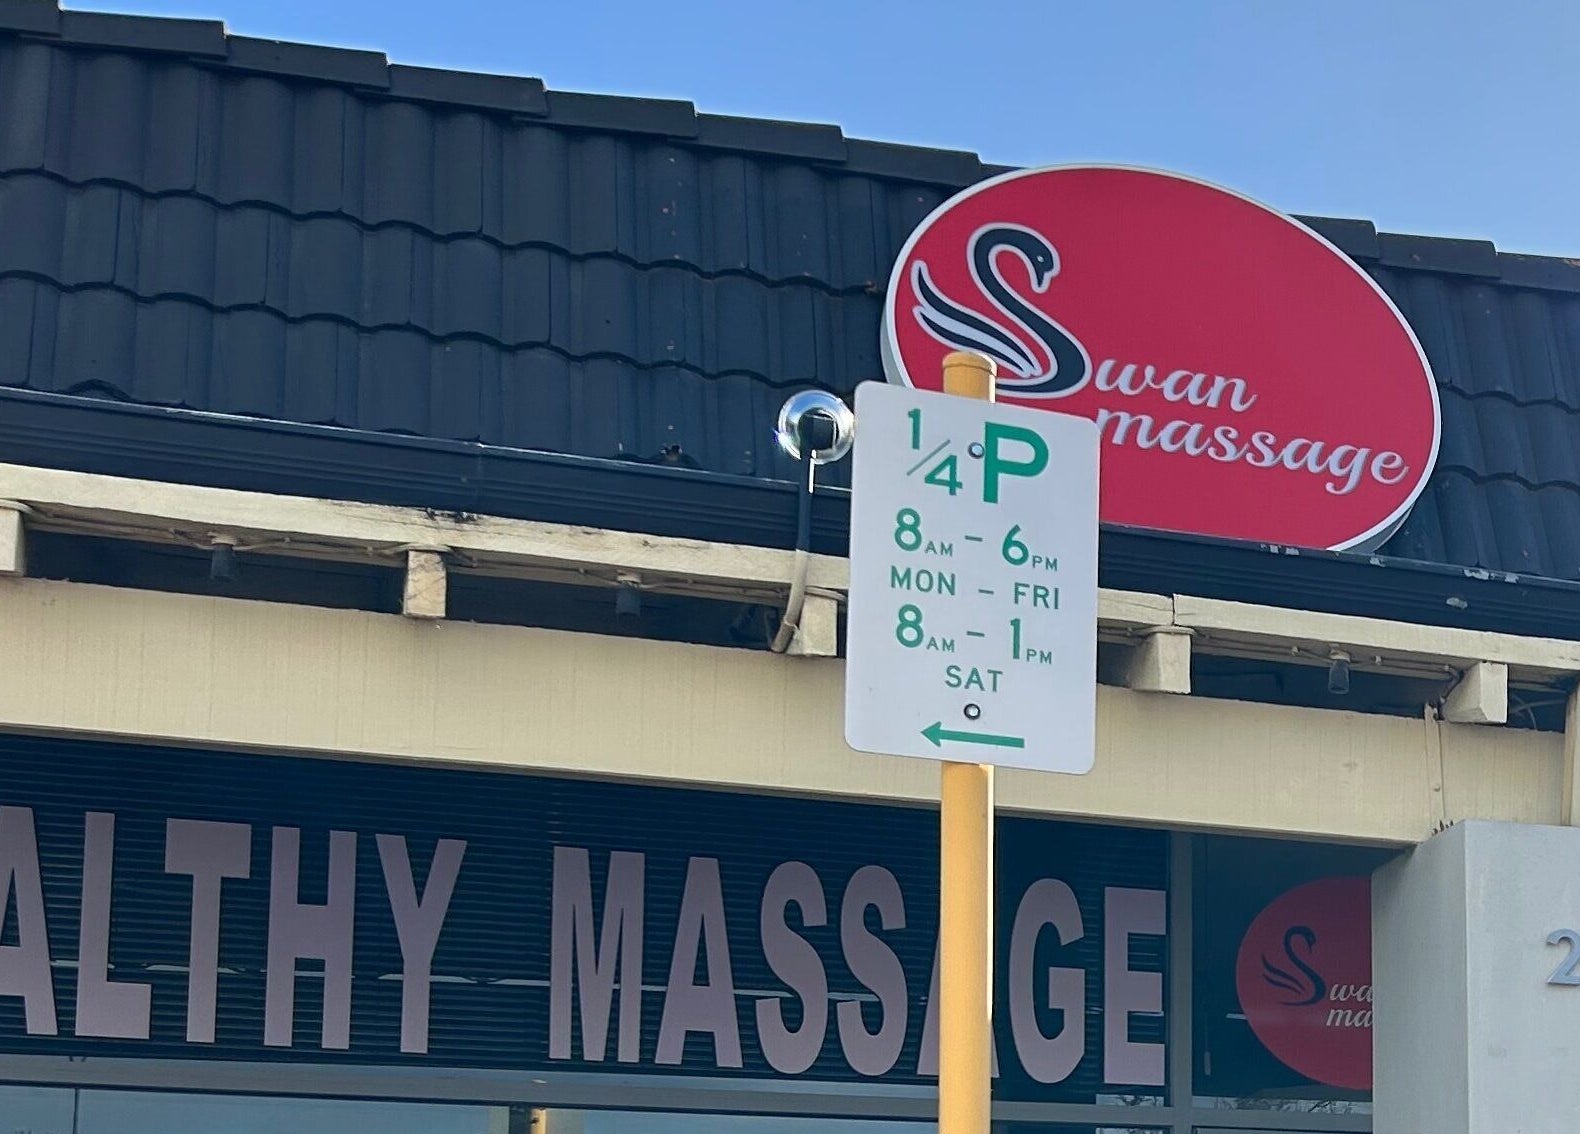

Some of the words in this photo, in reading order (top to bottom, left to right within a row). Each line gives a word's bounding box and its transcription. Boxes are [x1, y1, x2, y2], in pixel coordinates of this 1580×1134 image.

[1095, 405, 1409, 496] massage
[889, 564, 957, 597] MON
[1012, 582, 1060, 611] FRI
[944, 664, 1003, 693] SAT
[548, 846, 1167, 1086] MASSGE
